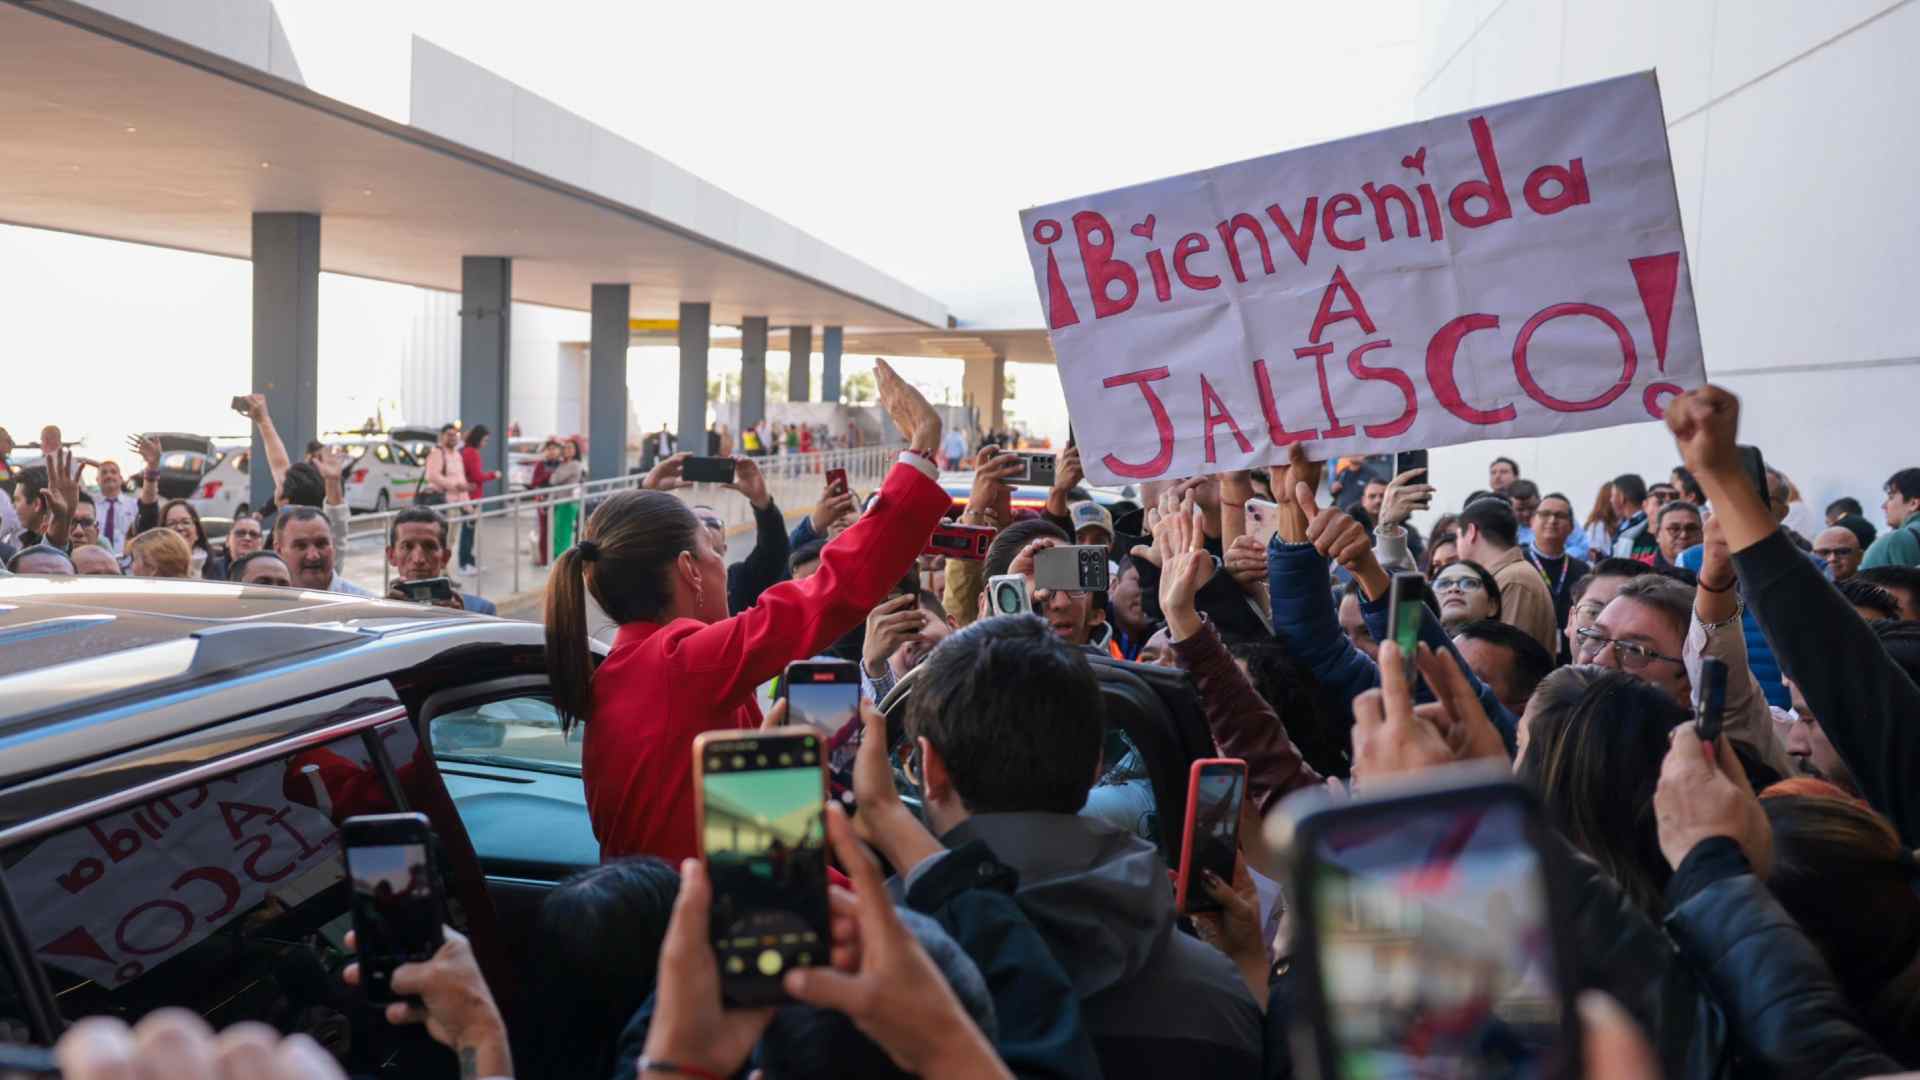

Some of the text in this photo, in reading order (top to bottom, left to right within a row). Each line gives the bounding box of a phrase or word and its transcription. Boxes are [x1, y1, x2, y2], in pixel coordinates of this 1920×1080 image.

[1032, 115, 1591, 330] ¡Bienvenida
[1309, 264, 1376, 344] A
[1102, 250, 1686, 479] JALISCO!
